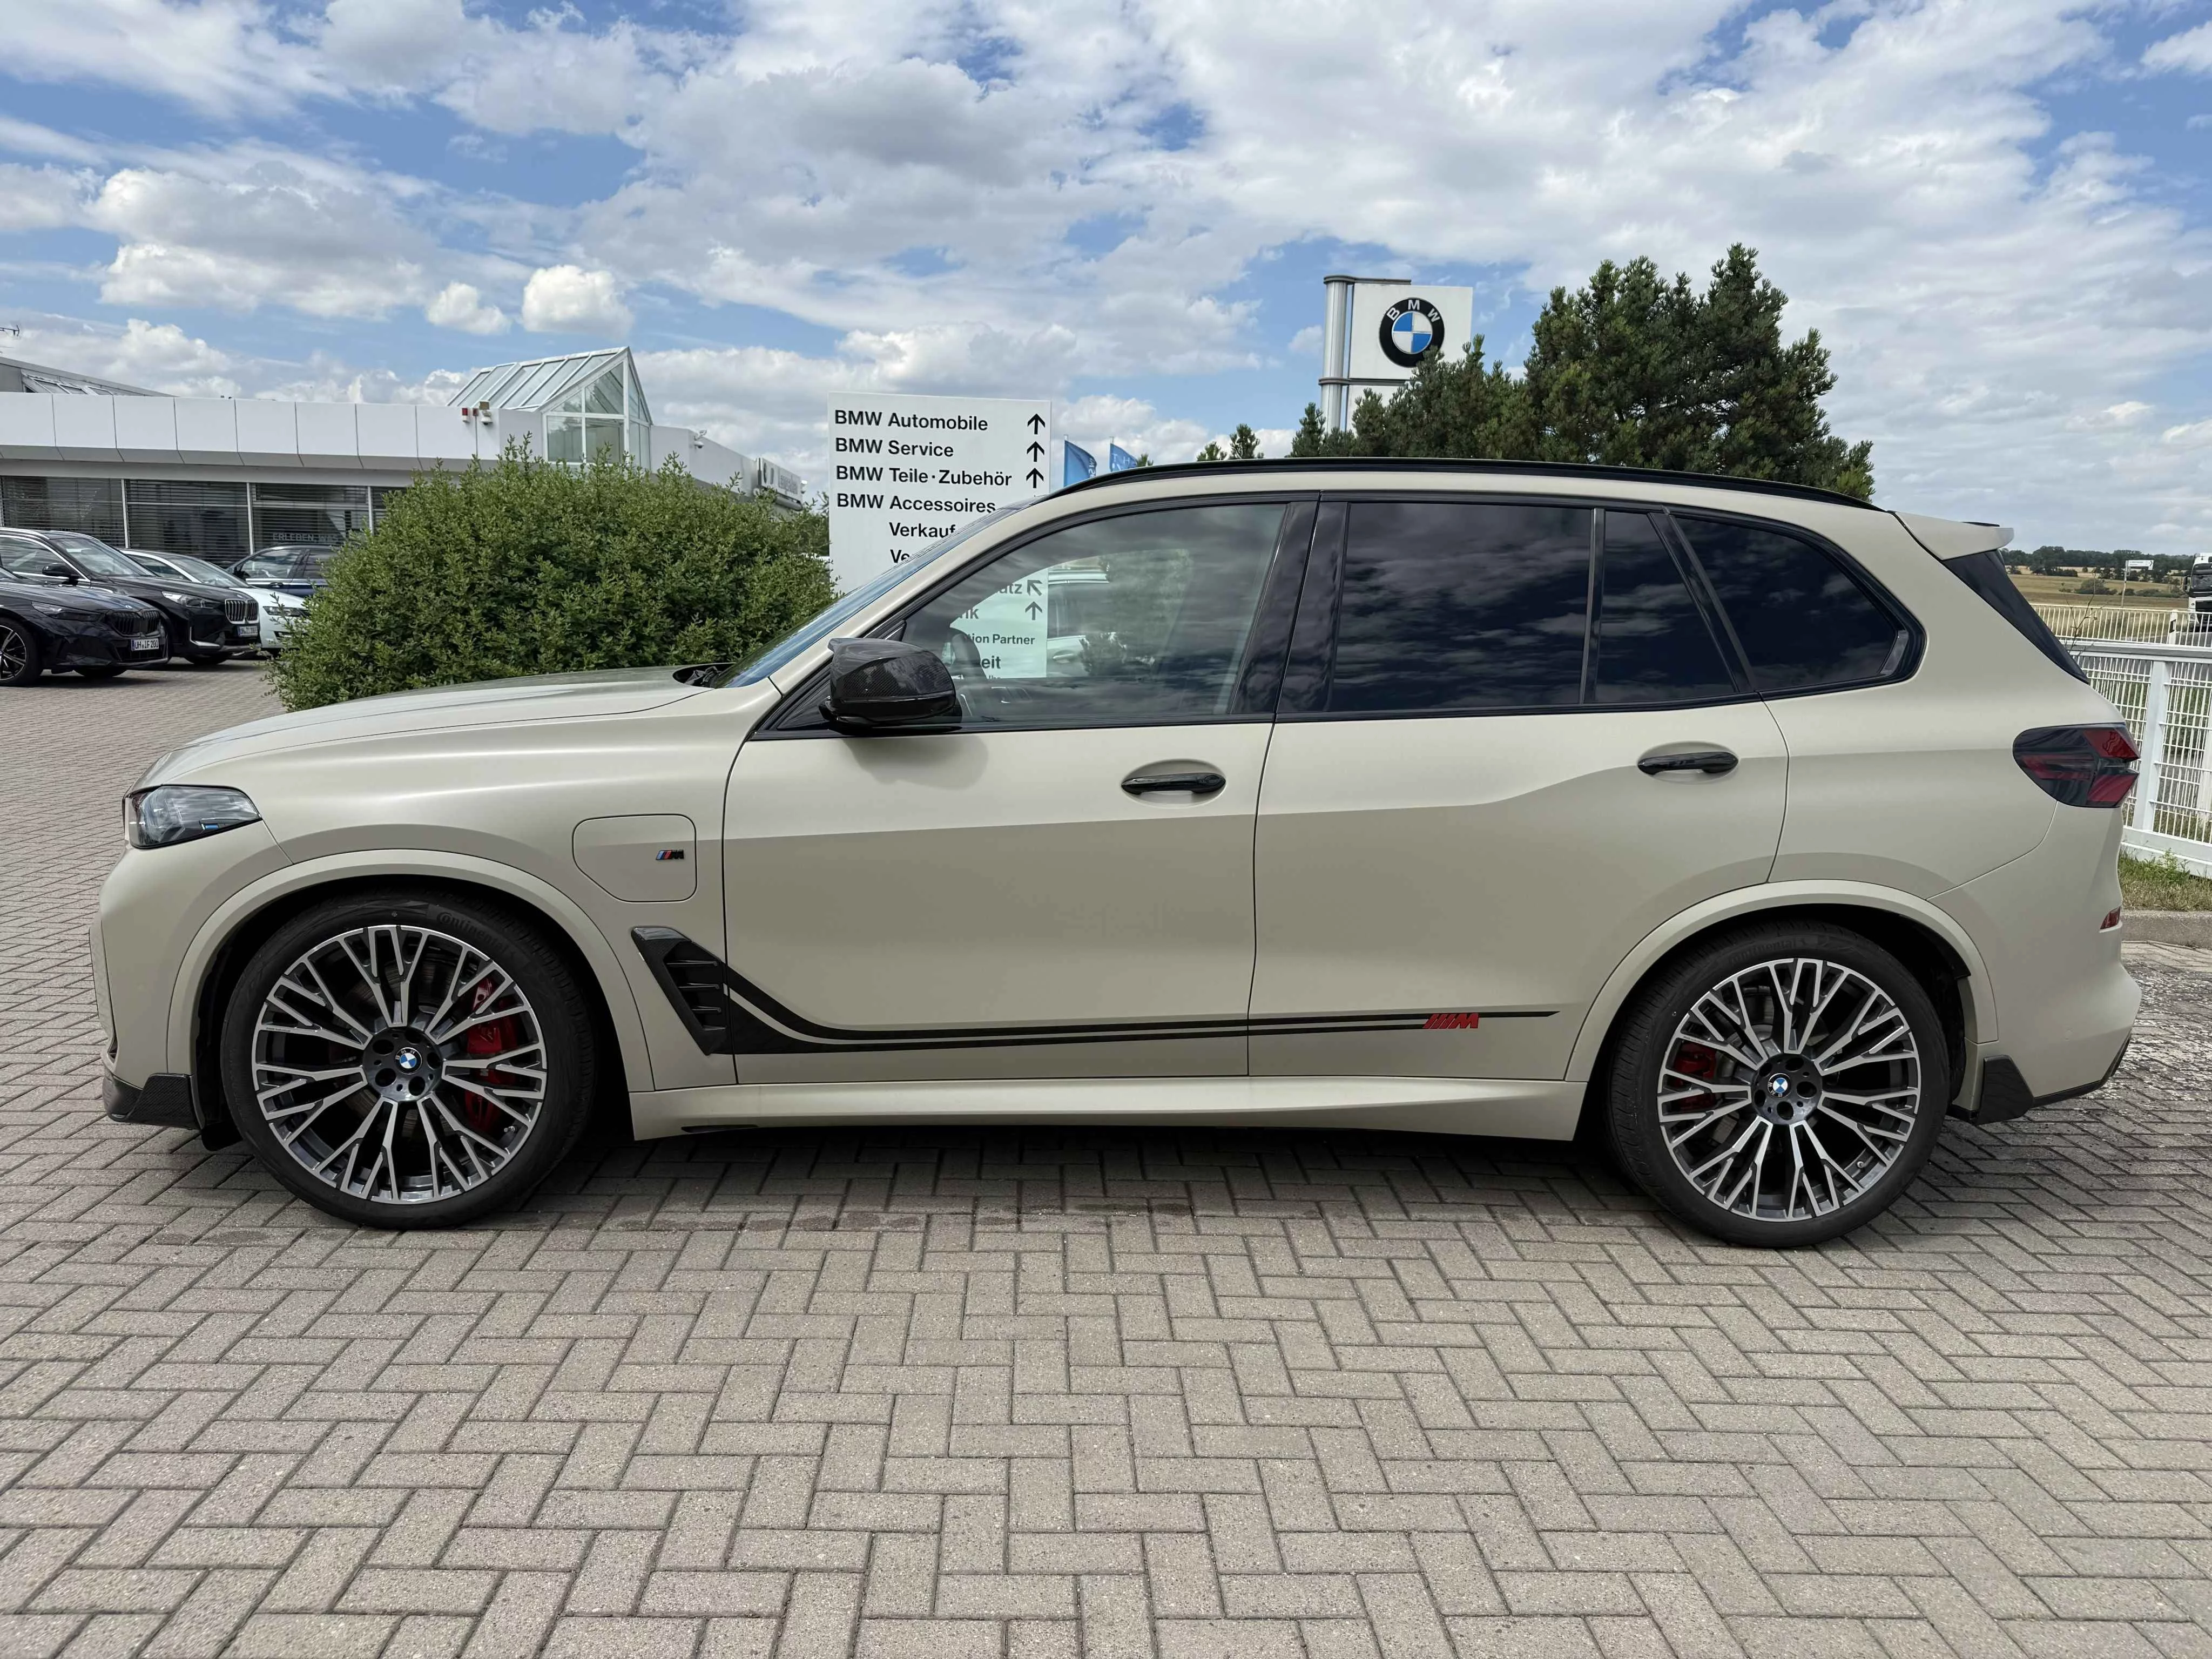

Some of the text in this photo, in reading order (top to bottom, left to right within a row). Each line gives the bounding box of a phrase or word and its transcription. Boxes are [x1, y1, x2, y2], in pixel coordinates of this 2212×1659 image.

[1386, 299, 1440, 322] BMW
[835, 410, 988, 430] BMW Automobile
[835, 437, 954, 457] BMW Service
[837, 466, 884, 481] BMW
[837, 493, 996, 513] BMW Accessoires
[889, 522, 956, 538] Verkauf
[993, 634, 1035, 644] Partner
